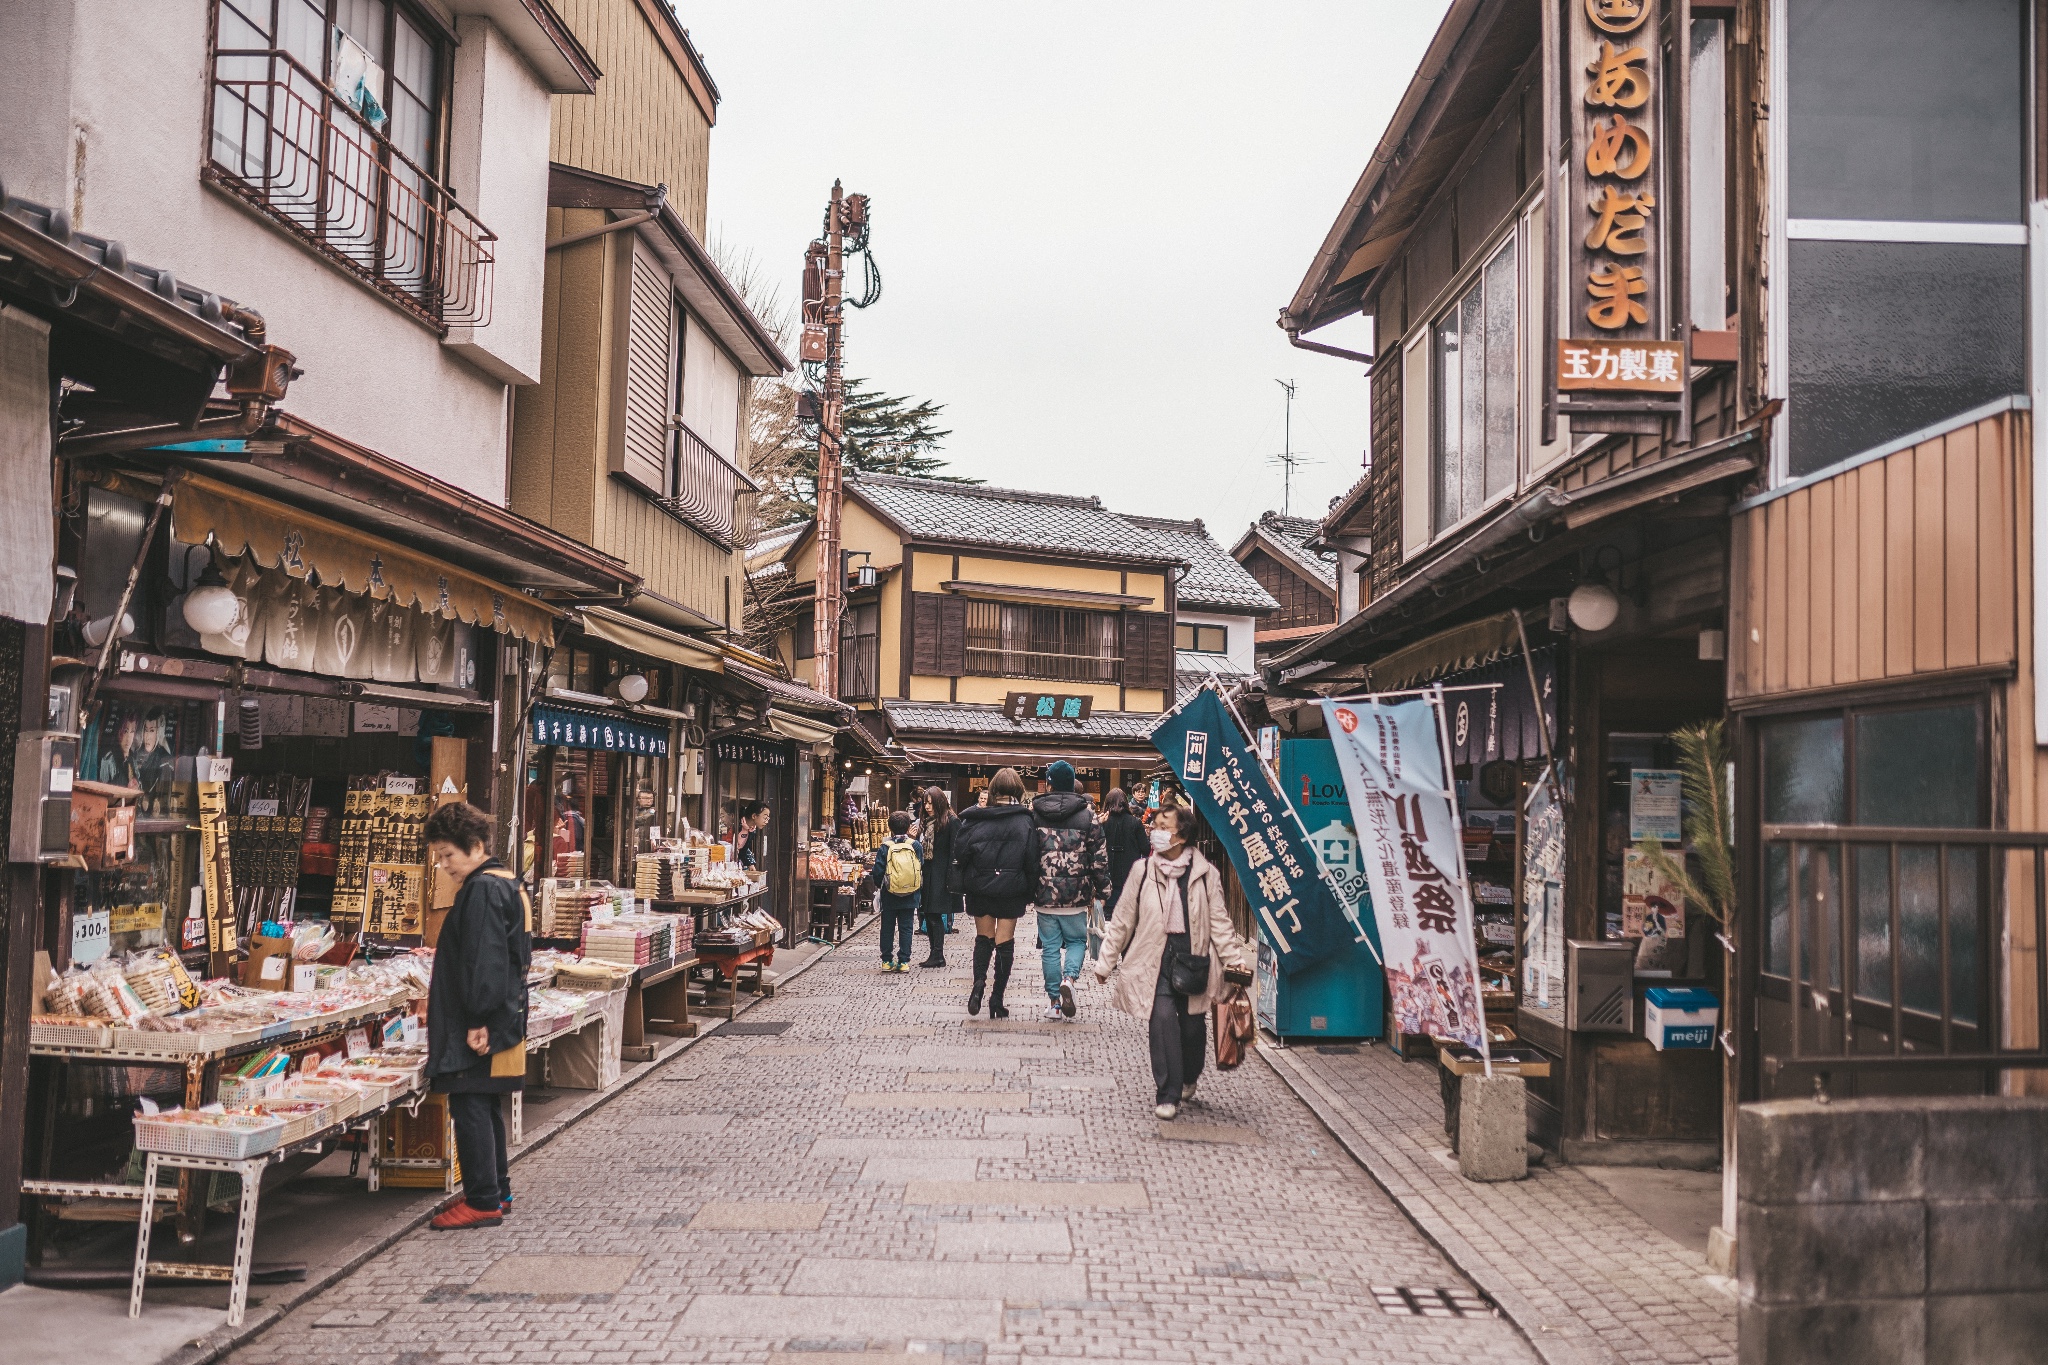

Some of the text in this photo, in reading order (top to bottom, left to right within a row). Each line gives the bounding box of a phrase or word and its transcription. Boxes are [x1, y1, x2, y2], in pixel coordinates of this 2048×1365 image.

[1585, 40, 1655, 329] あめだま
[1562, 347, 1679, 383] 玉力製菓
[537, 719, 598, 744] 菓子屋横丁
[1187, 742, 1203, 773] 川越
[1312, 785, 1346, 798] LOV
[1206, 767, 1303, 934] 菓子屋横丁
[385, 870, 408, 931] 焼き芋味
[1671, 1029, 1708, 1044] meiji
